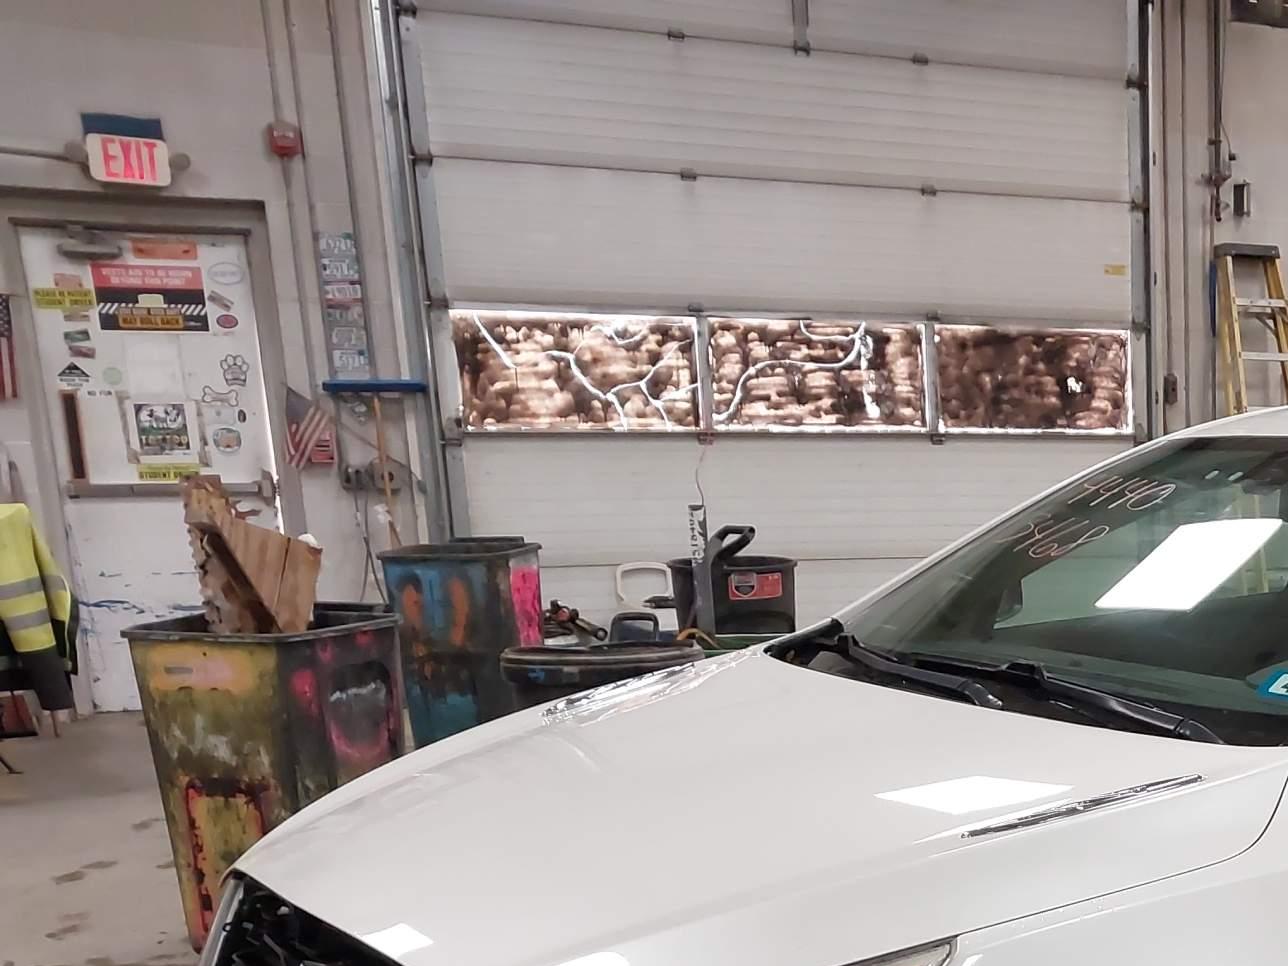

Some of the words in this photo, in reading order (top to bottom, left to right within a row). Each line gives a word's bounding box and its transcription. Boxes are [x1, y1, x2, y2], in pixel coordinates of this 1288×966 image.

[101, 137, 157, 181] EXIT
[1067, 475, 1176, 511] 4440
[995, 514, 1110, 558] 3468
